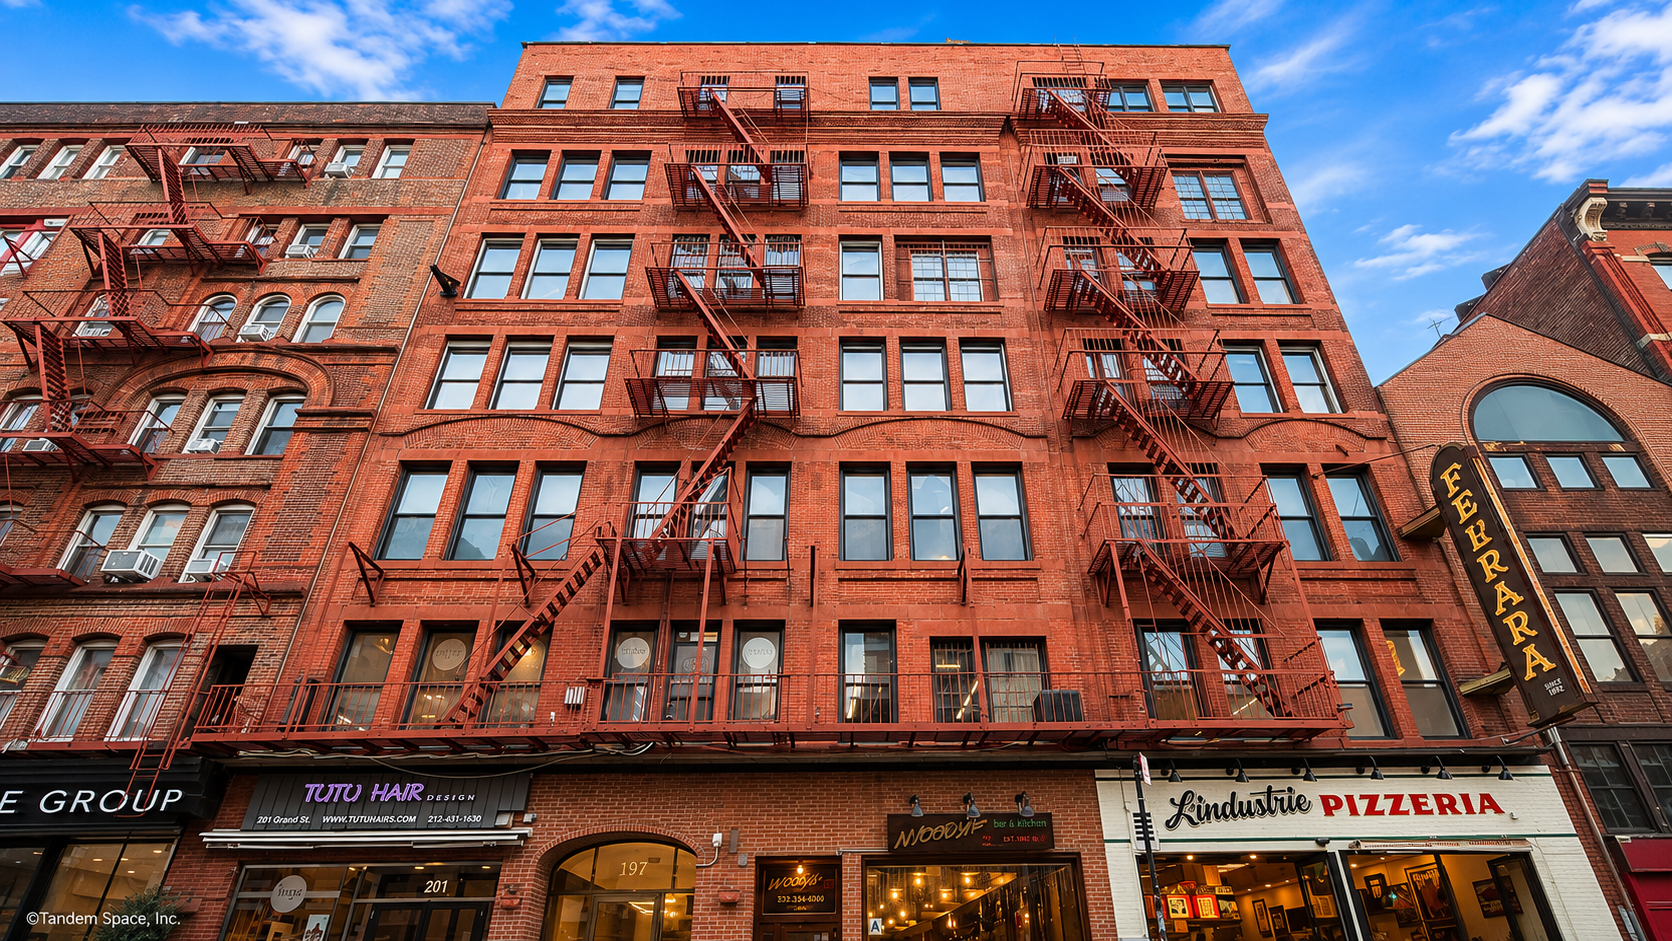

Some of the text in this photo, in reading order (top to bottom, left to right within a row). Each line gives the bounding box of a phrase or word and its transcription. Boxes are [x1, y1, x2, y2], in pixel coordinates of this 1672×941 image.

[39, 788, 184, 814] GROUP
[304, 783, 477, 804] TUTU HAIR DESIGN
[1318, 792, 1506, 819] PIZZERIA
[256, 815, 483, 824] 201 Grand St. WWW.TUTUHAIRS.COM 212-431-1630
[618, 861, 648, 877] 197
[423, 879, 448, 894] 201
[870, 919, 880, 933] A
